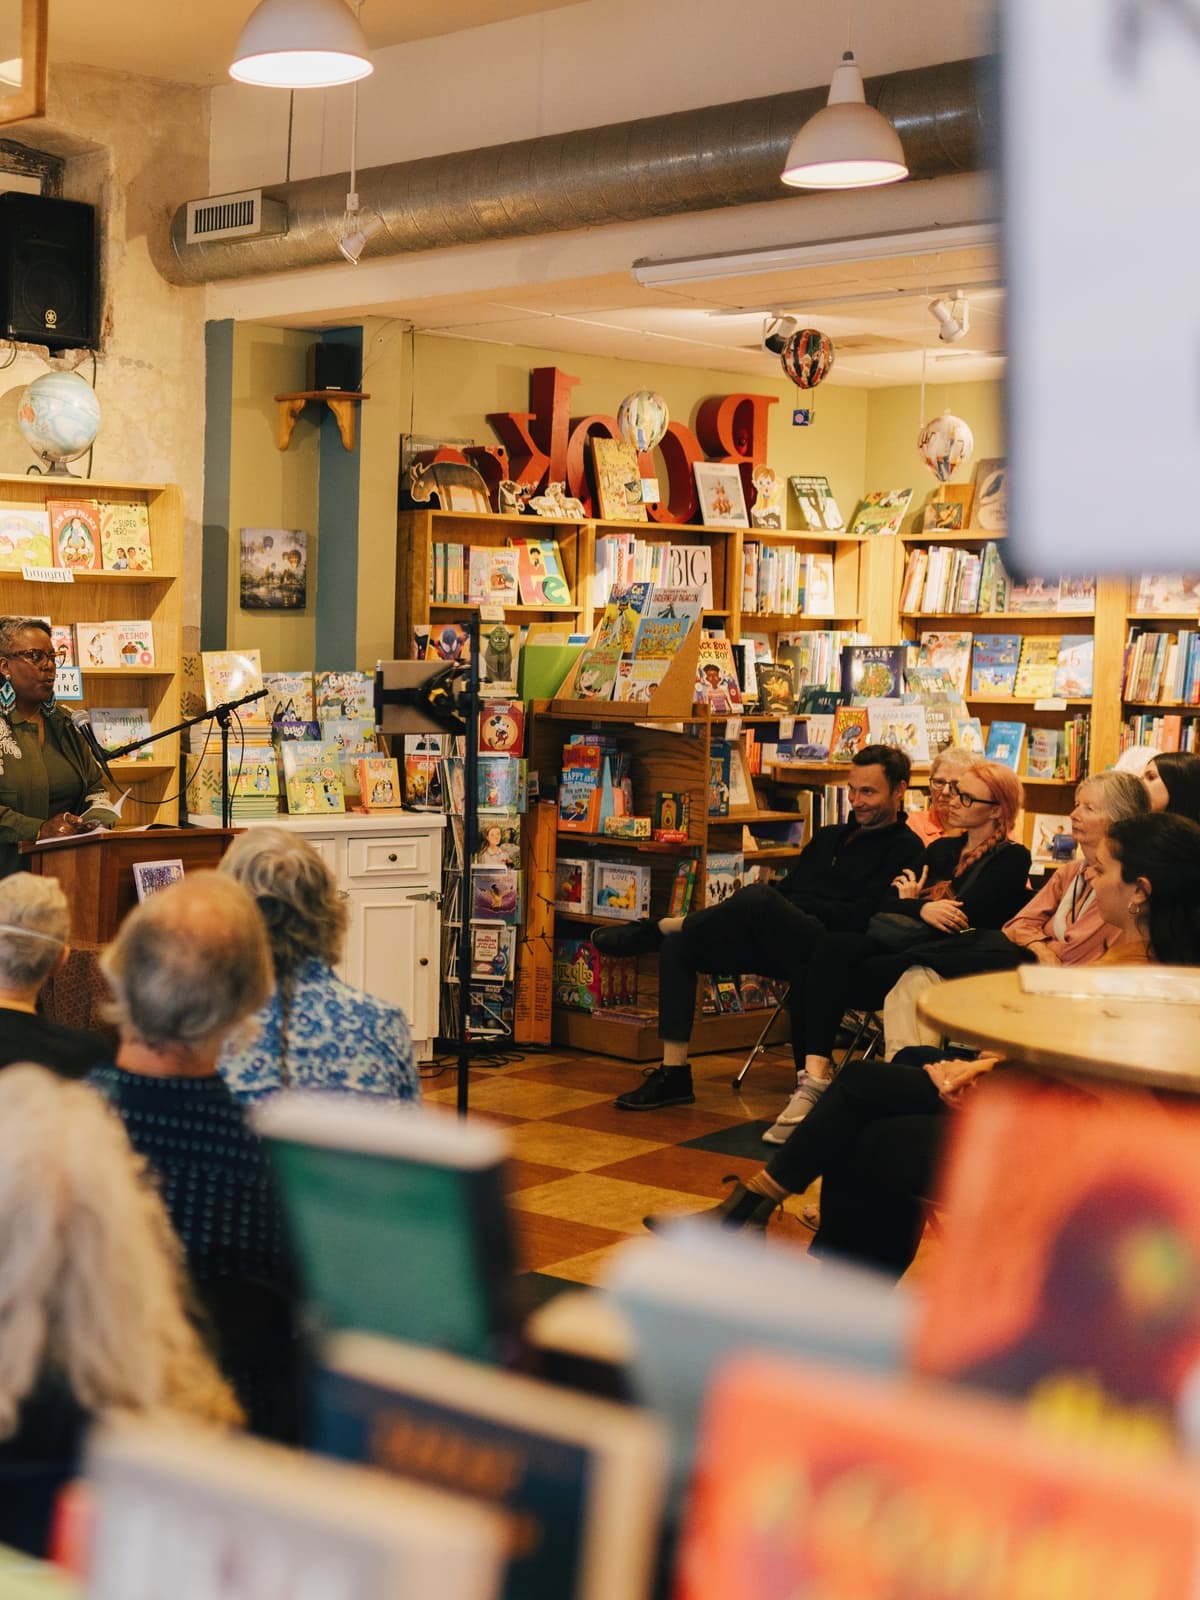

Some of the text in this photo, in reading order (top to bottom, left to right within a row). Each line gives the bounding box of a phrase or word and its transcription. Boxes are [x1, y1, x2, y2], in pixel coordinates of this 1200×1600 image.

[671, 550, 708, 587] BIG
[854, 650, 895, 658] PLANET
[368, 760, 393, 769] LOVE
